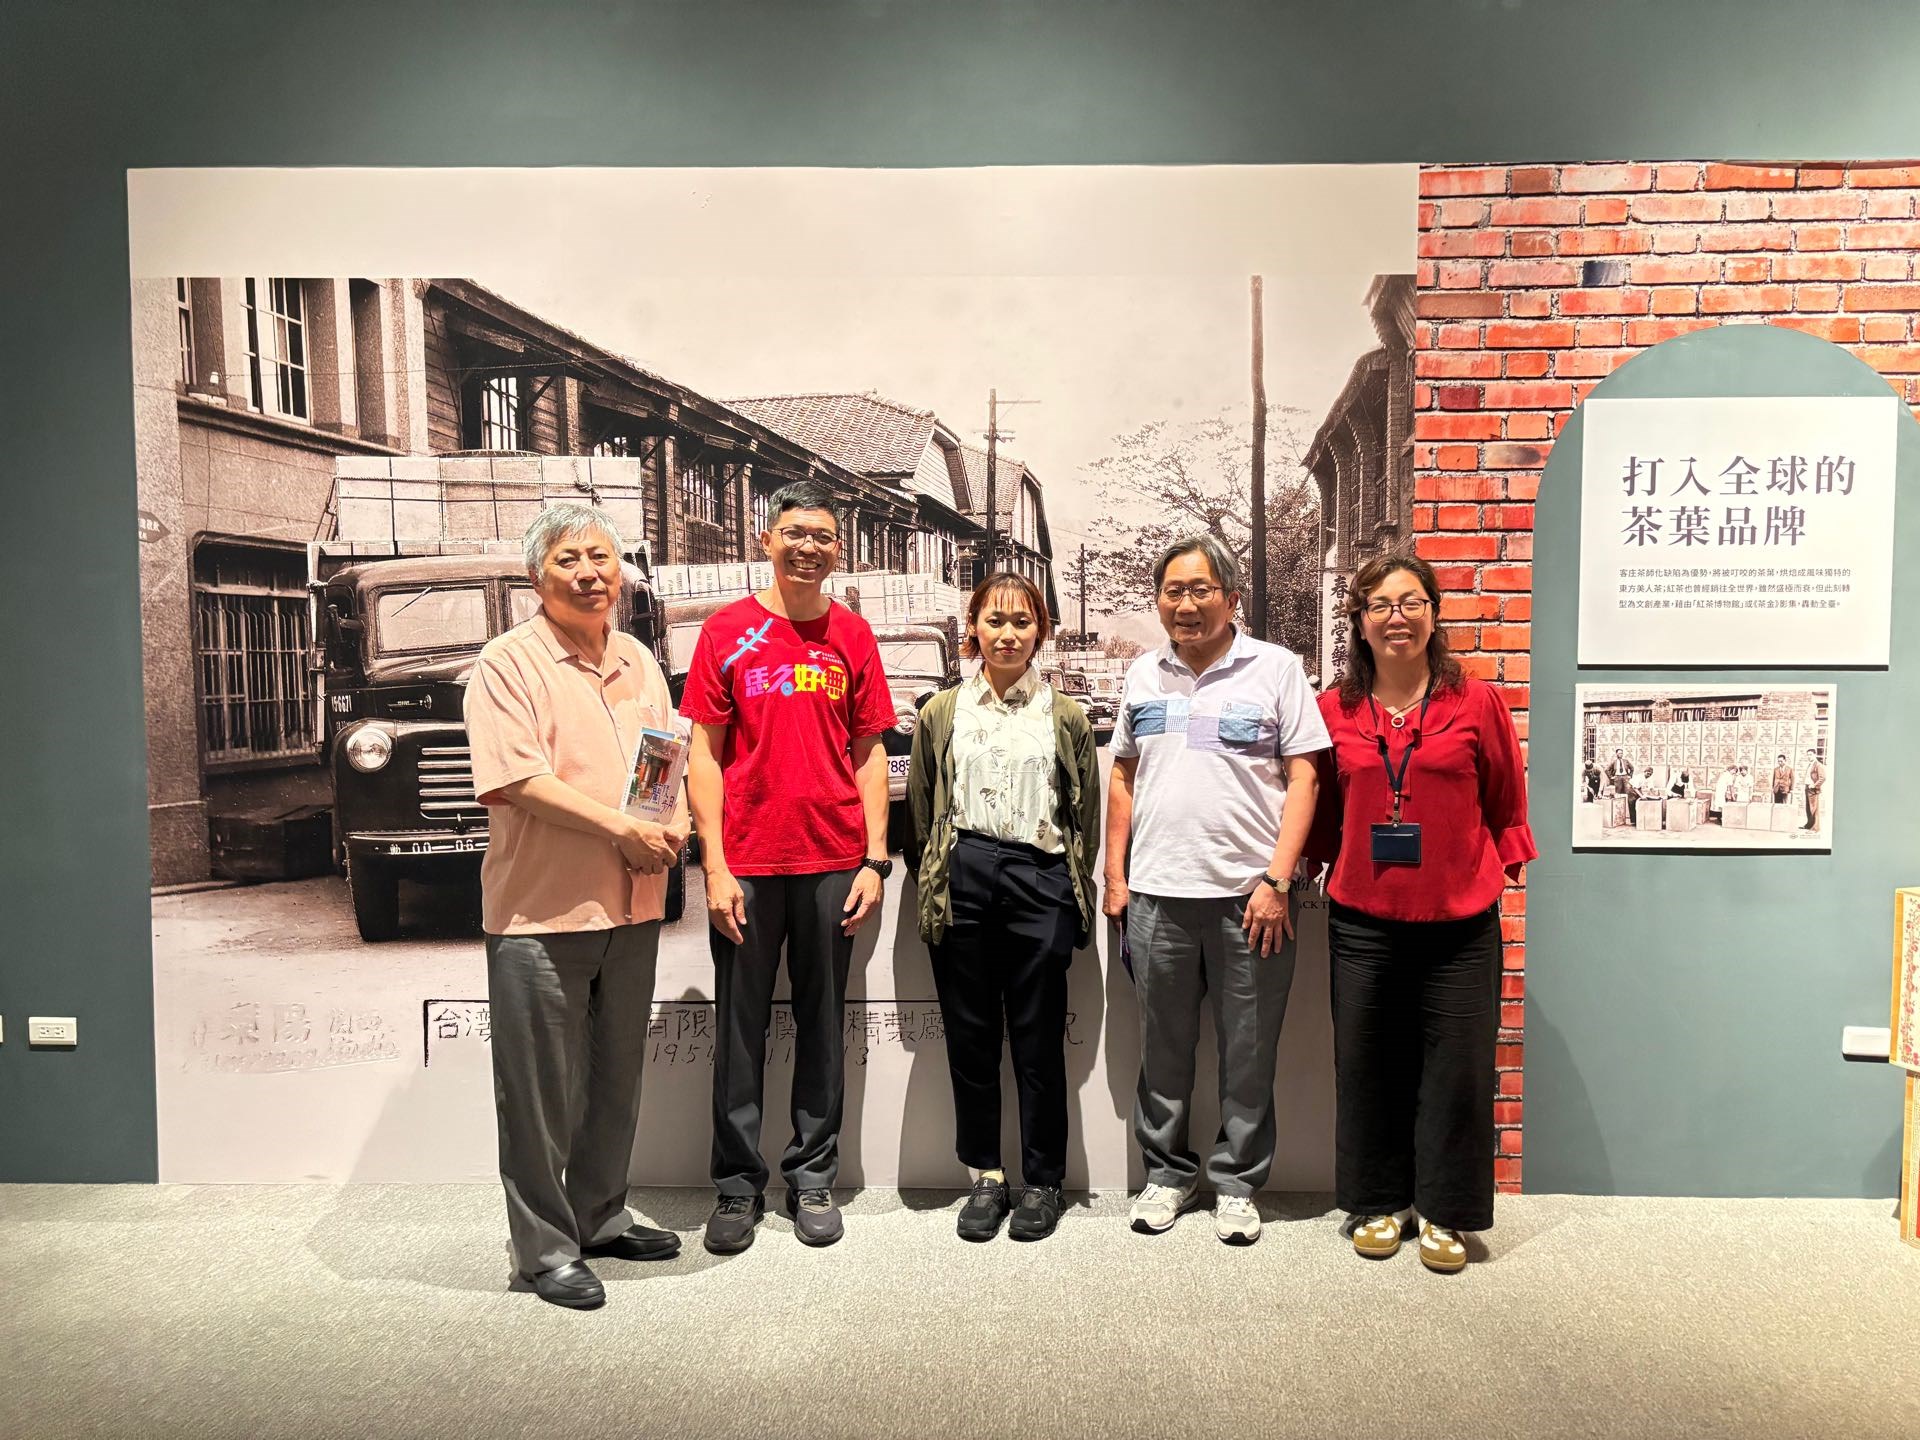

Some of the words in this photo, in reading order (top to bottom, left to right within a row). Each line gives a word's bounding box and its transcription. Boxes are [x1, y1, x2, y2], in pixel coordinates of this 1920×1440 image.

[1622, 455, 1856, 496] 打入全球的
[1621, 505, 1806, 546] 茶葉品牌
[888, 760, 910, 773] 885
